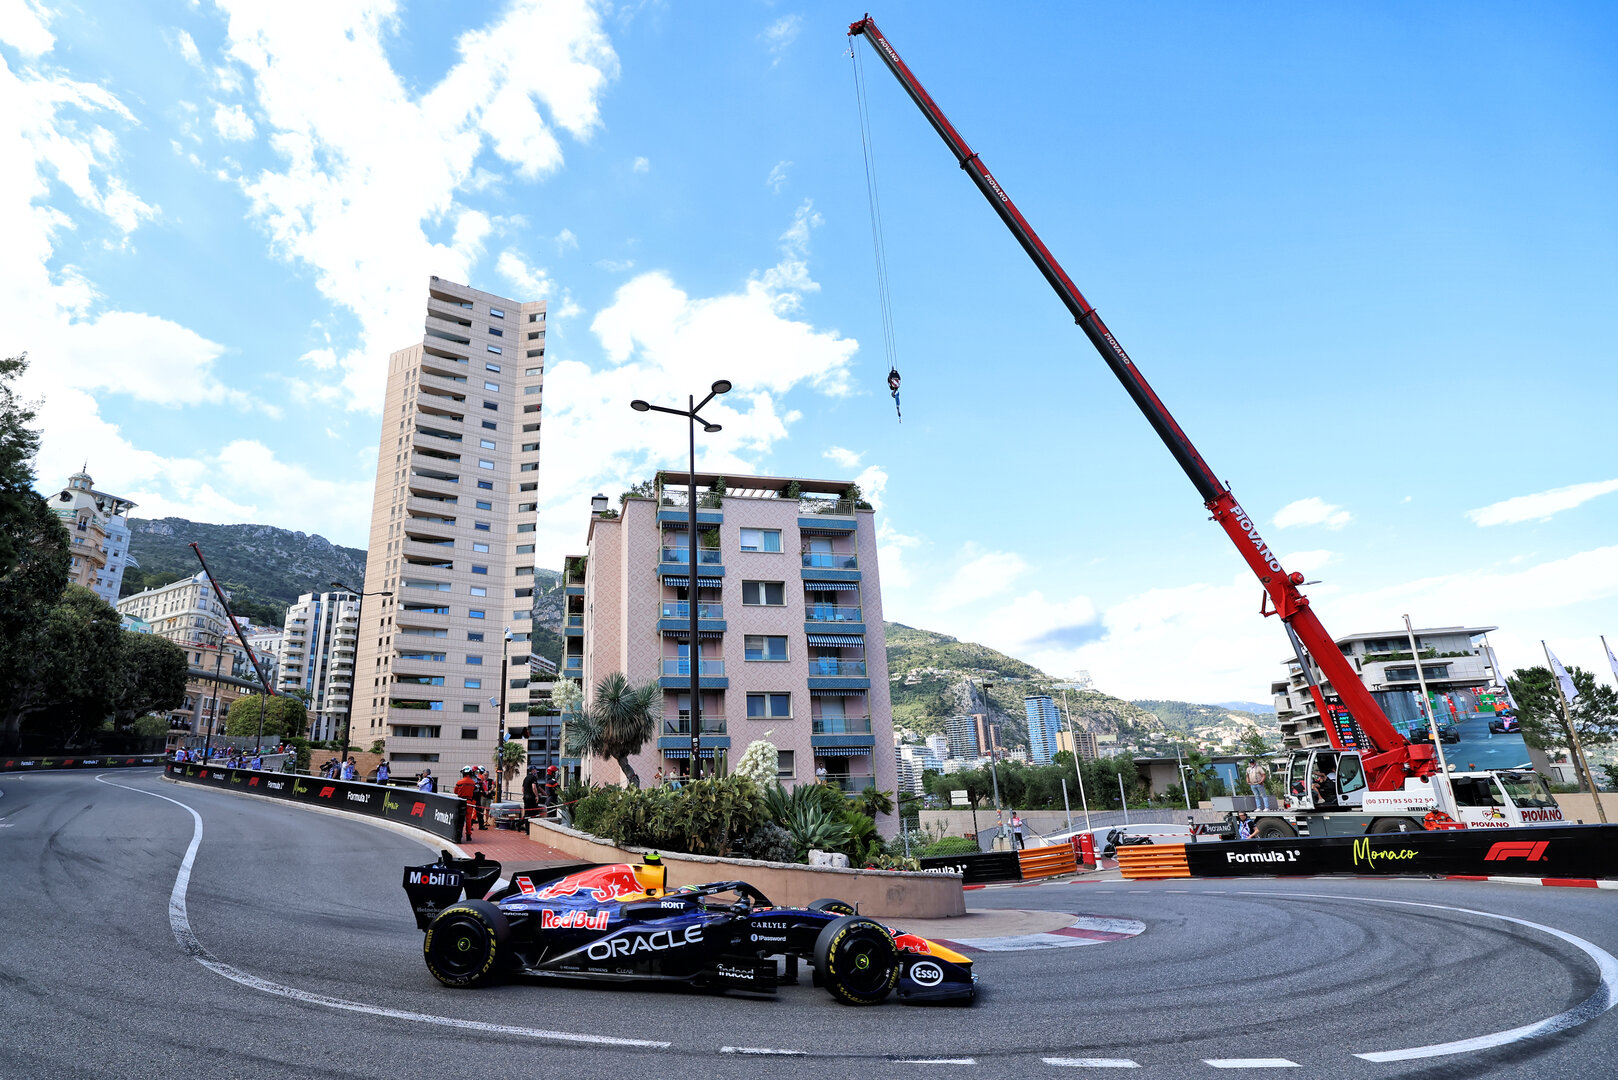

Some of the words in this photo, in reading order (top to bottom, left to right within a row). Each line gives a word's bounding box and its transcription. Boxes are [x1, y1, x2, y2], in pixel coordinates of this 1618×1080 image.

[878, 38, 899, 62] PIOVANO
[984, 174, 1008, 202] PIOVANO
[1104, 332, 1130, 364] PIOVANO
[1230, 505, 1281, 572] PIOVANO
[347, 791, 365, 802] Formula
[434, 809, 448, 824] Formula
[1521, 809, 1562, 821] PIOVANO
[1227, 850, 1285, 863] Formula
[1354, 837, 1419, 869] Monaco
[410, 872, 445, 885] Mobil
[541, 909, 574, 929] Red
[574, 911, 610, 931] Bull
[588, 924, 704, 960] ORACLE
[830, 929, 846, 963] ZERO
[915, 967, 939, 979] Esso
